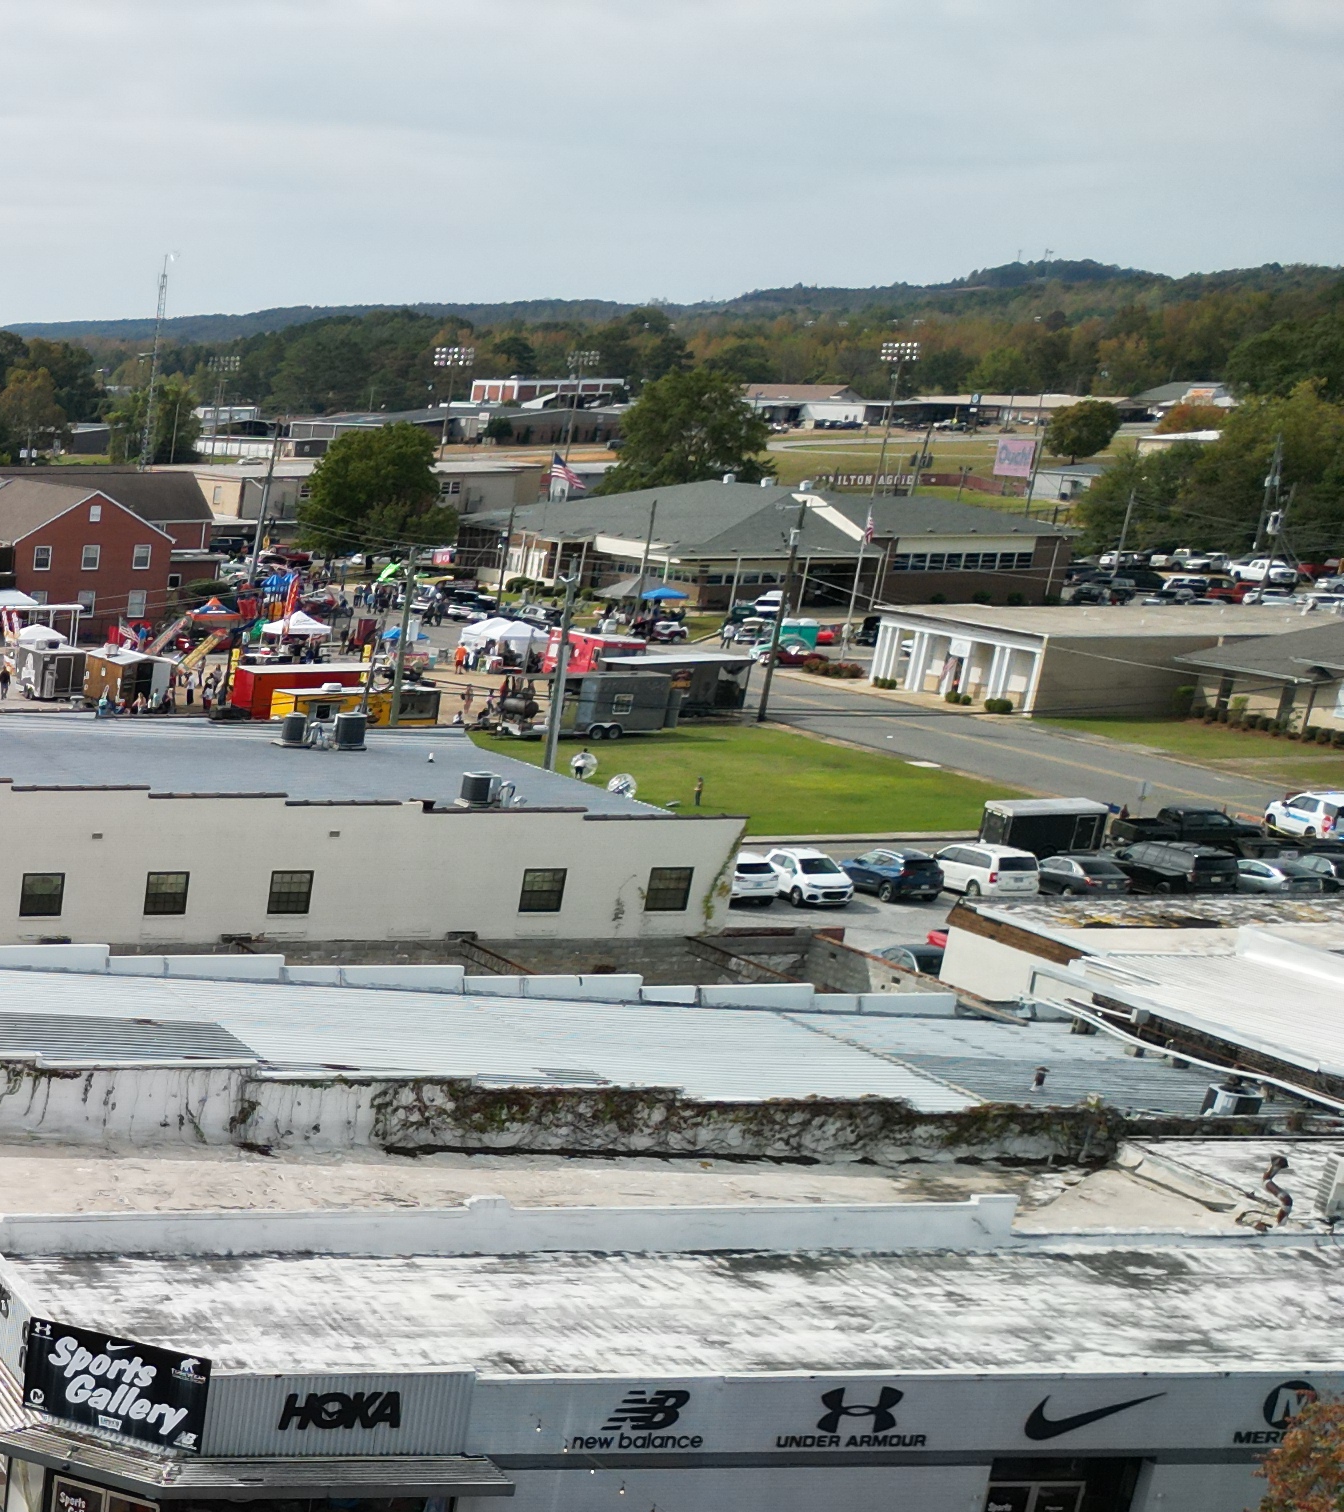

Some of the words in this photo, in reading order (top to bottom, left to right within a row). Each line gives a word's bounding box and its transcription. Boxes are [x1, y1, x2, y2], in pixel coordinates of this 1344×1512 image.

[48, 1336, 157, 1388] Sports
[65, 1374, 188, 1435] Gallery
[278, 1391, 401, 1430] HOKA
[572, 1435, 612, 1449] new
[618, 1432, 703, 1449] balance
[776, 1435, 840, 1448] UNDER
[845, 1434, 927, 1448] ARMOUR
[60, 1492, 86, 1508] Sports
